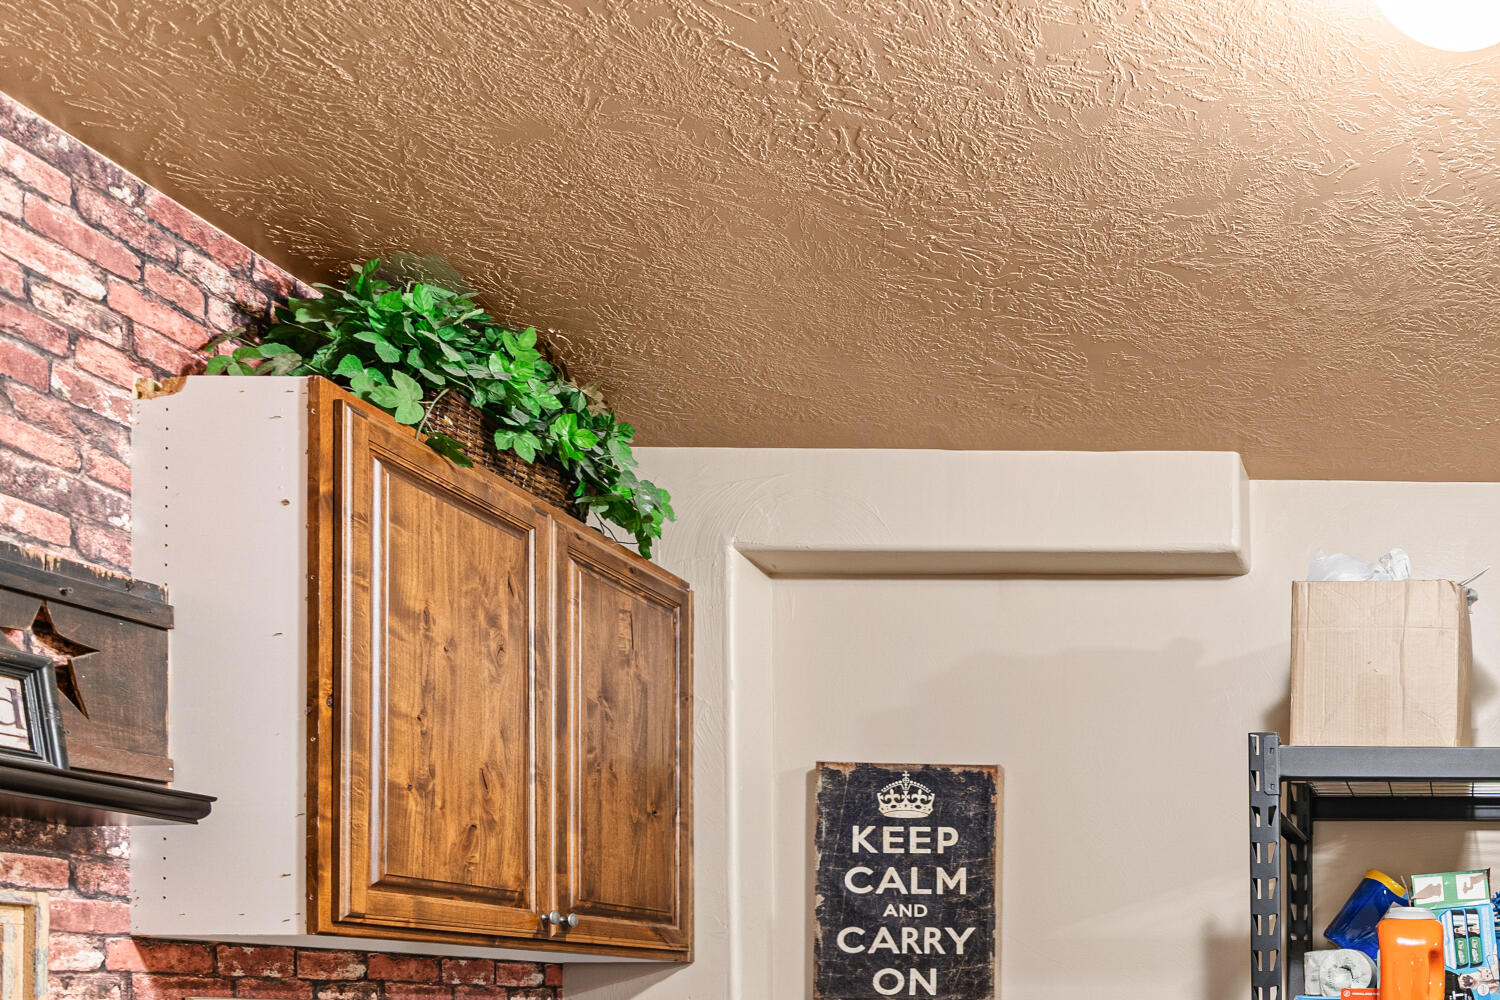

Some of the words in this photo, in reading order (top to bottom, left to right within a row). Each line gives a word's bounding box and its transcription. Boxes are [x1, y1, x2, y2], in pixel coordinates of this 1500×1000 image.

[851, 825, 960, 854] KEEP
[844, 866, 967, 895] CALM
[882, 904, 928, 918] AND
[836, 926, 976, 955] CARRY
[872, 967, 937, 996] ON
